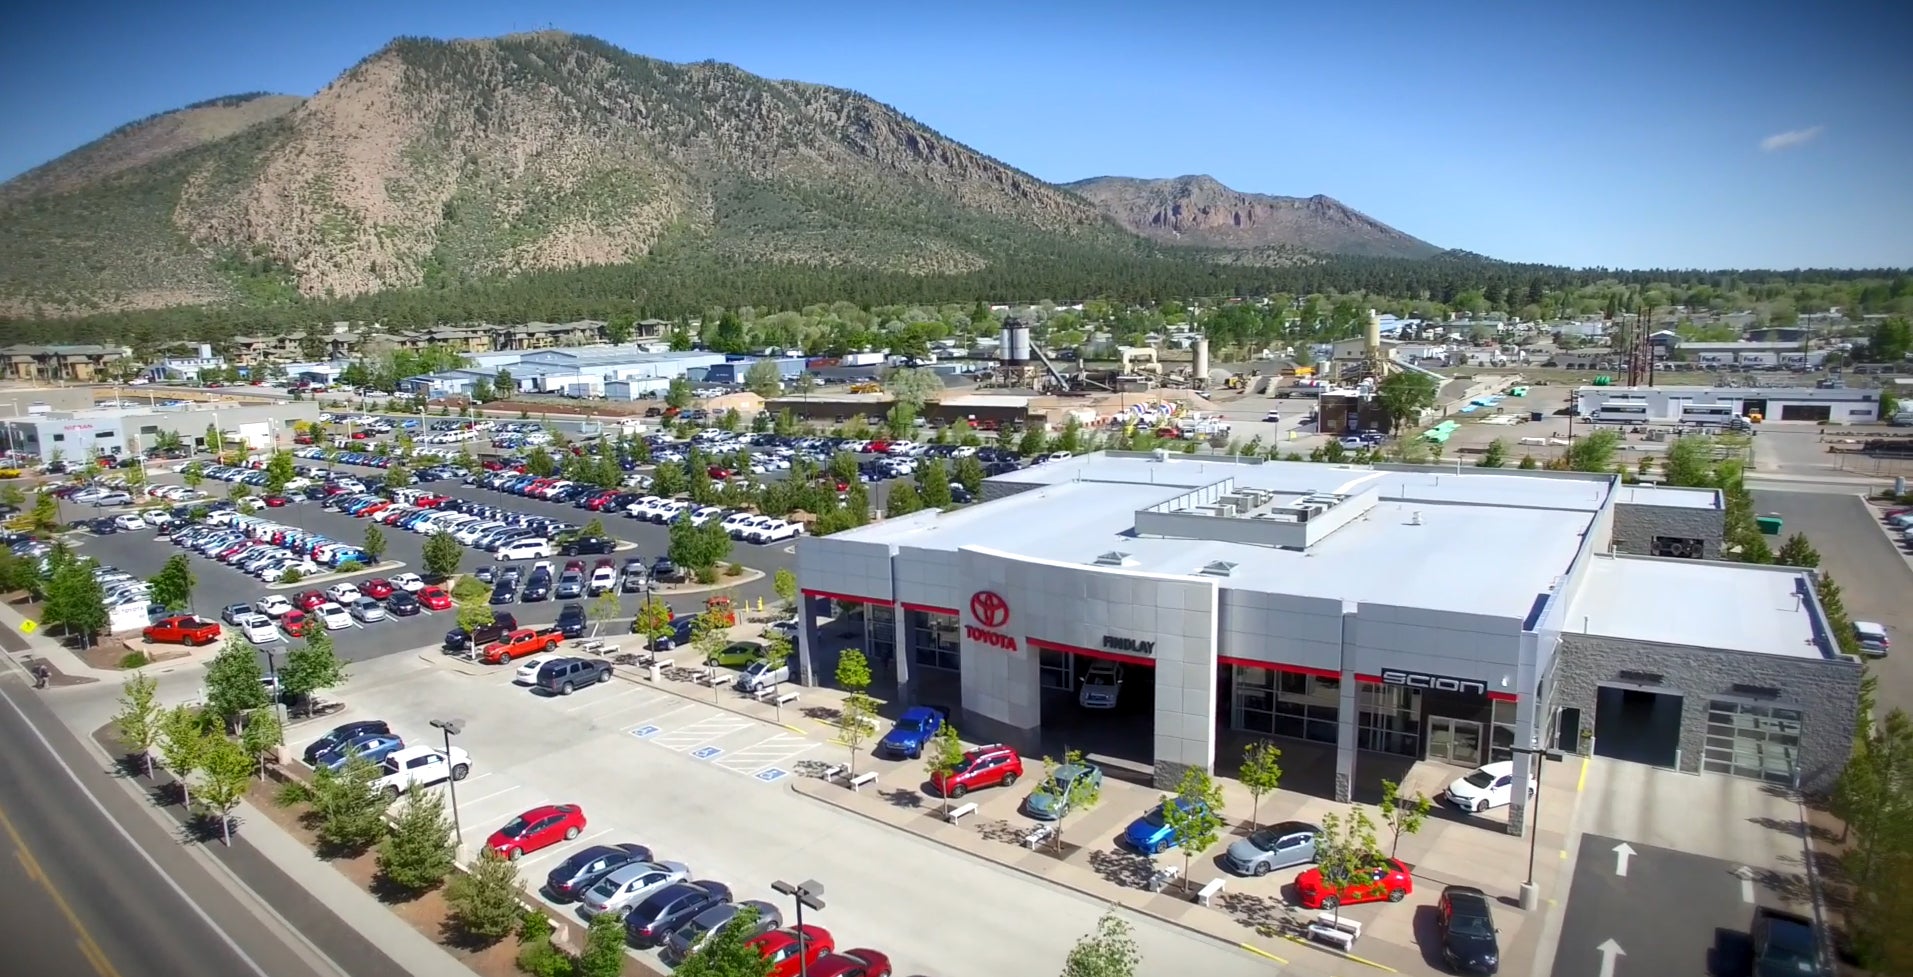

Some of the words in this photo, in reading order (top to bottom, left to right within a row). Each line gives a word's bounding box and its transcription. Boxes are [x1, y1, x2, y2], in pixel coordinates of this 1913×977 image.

[964, 624, 1017, 651] TOYOTA
[1103, 635, 1155, 654] FINDLAY
[1383, 671, 1484, 695] SCION
